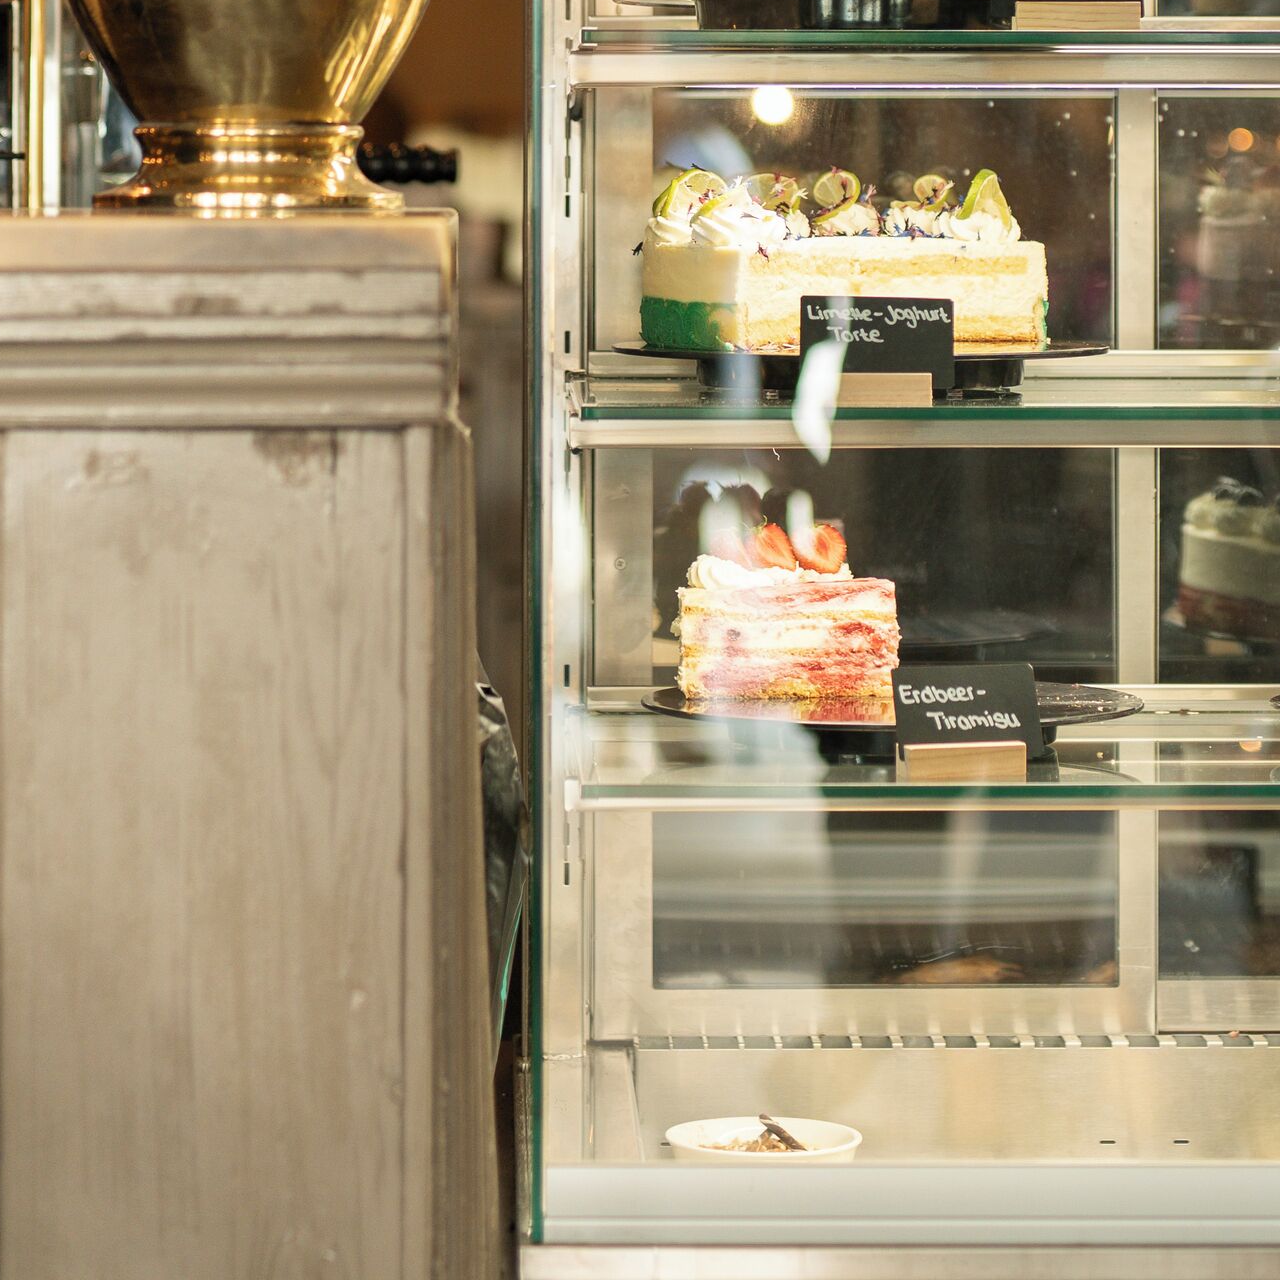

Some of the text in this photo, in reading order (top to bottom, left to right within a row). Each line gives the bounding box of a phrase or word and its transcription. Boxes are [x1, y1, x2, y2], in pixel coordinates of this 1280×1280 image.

[826, 326, 884, 343] Torte
[898, 684, 987, 705] Erdbeer-
[926, 710, 1021, 731] Tiramisu
